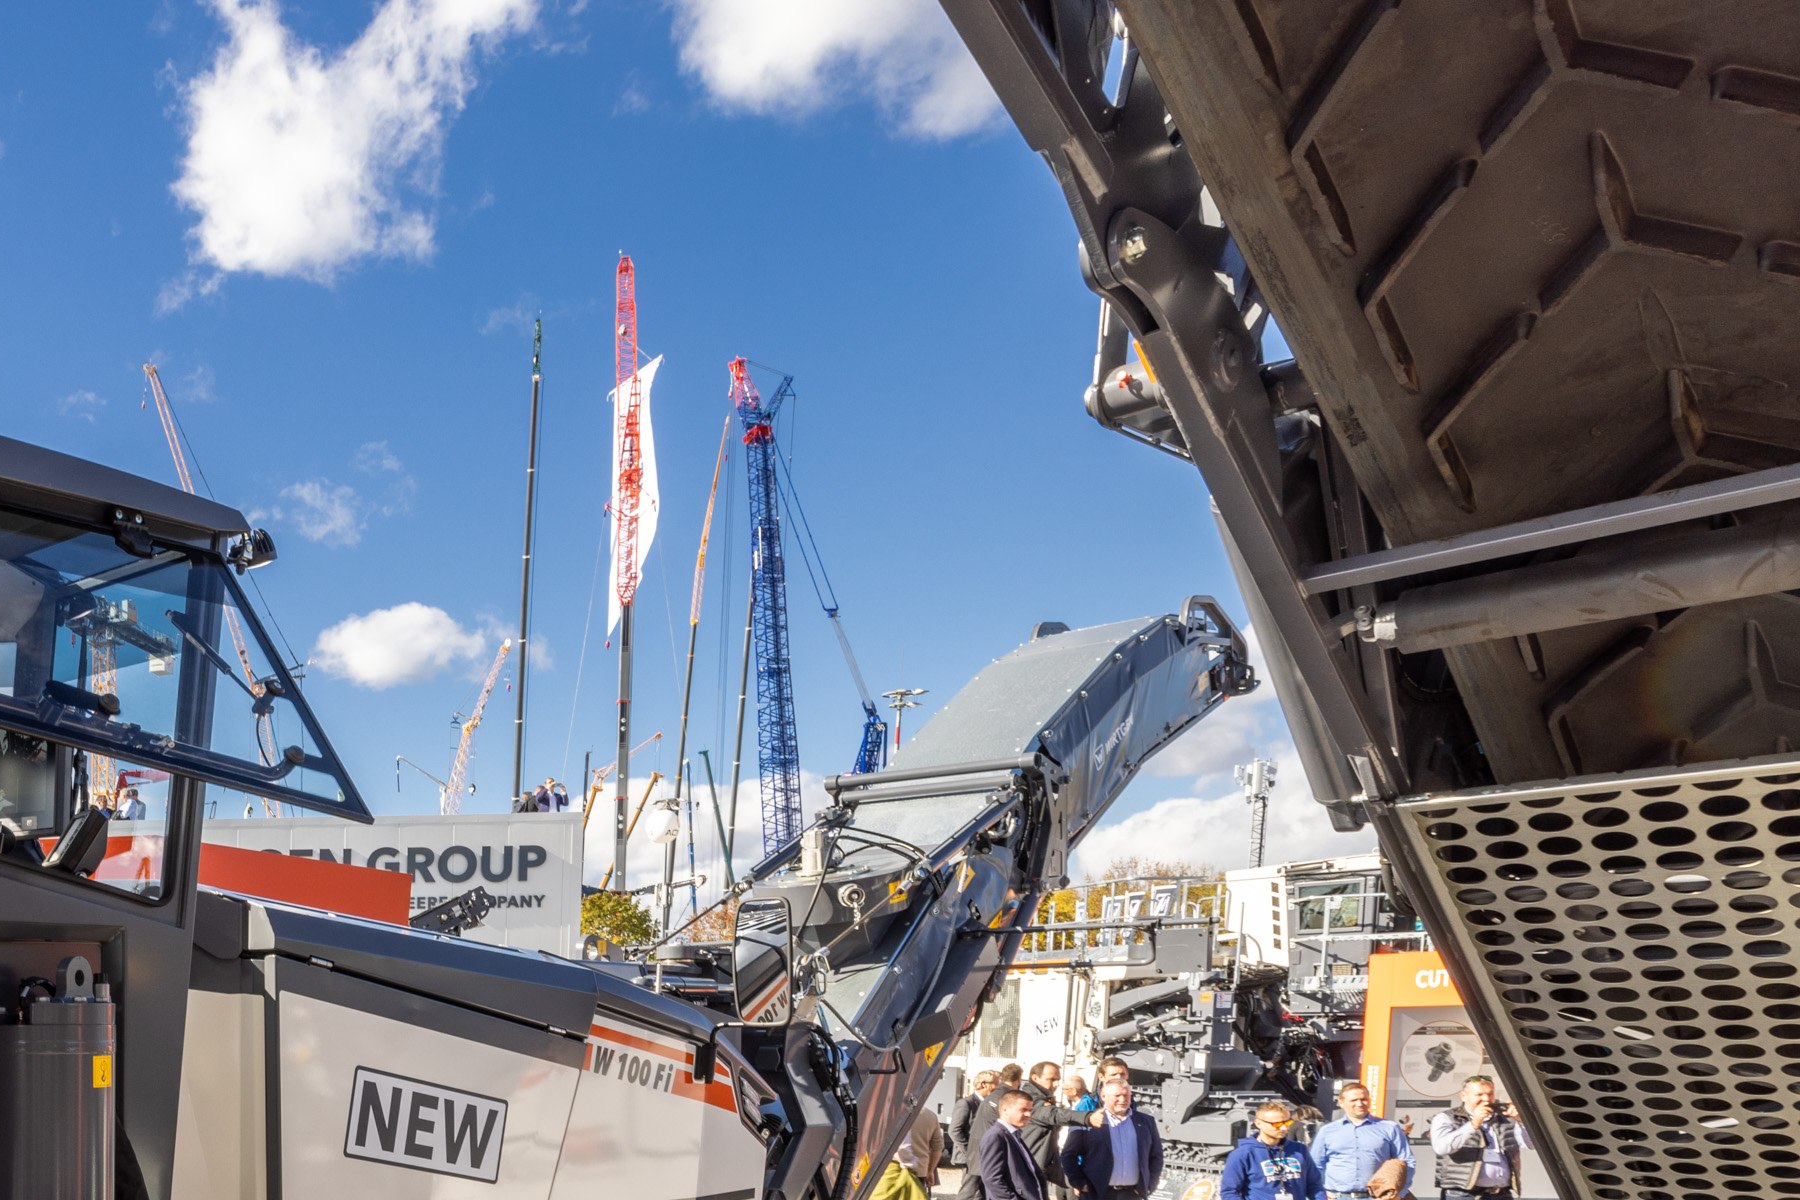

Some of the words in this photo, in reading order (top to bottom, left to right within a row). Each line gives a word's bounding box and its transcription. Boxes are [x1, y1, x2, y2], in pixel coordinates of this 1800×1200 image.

[366, 845, 547, 884] GROUP
[1035, 1016, 1060, 1036] NEW
[593, 1042, 615, 1077] W
[617, 1051, 651, 1089] 100
[653, 1063, 675, 1094] Fi
[354, 1079, 500, 1170] NEW
